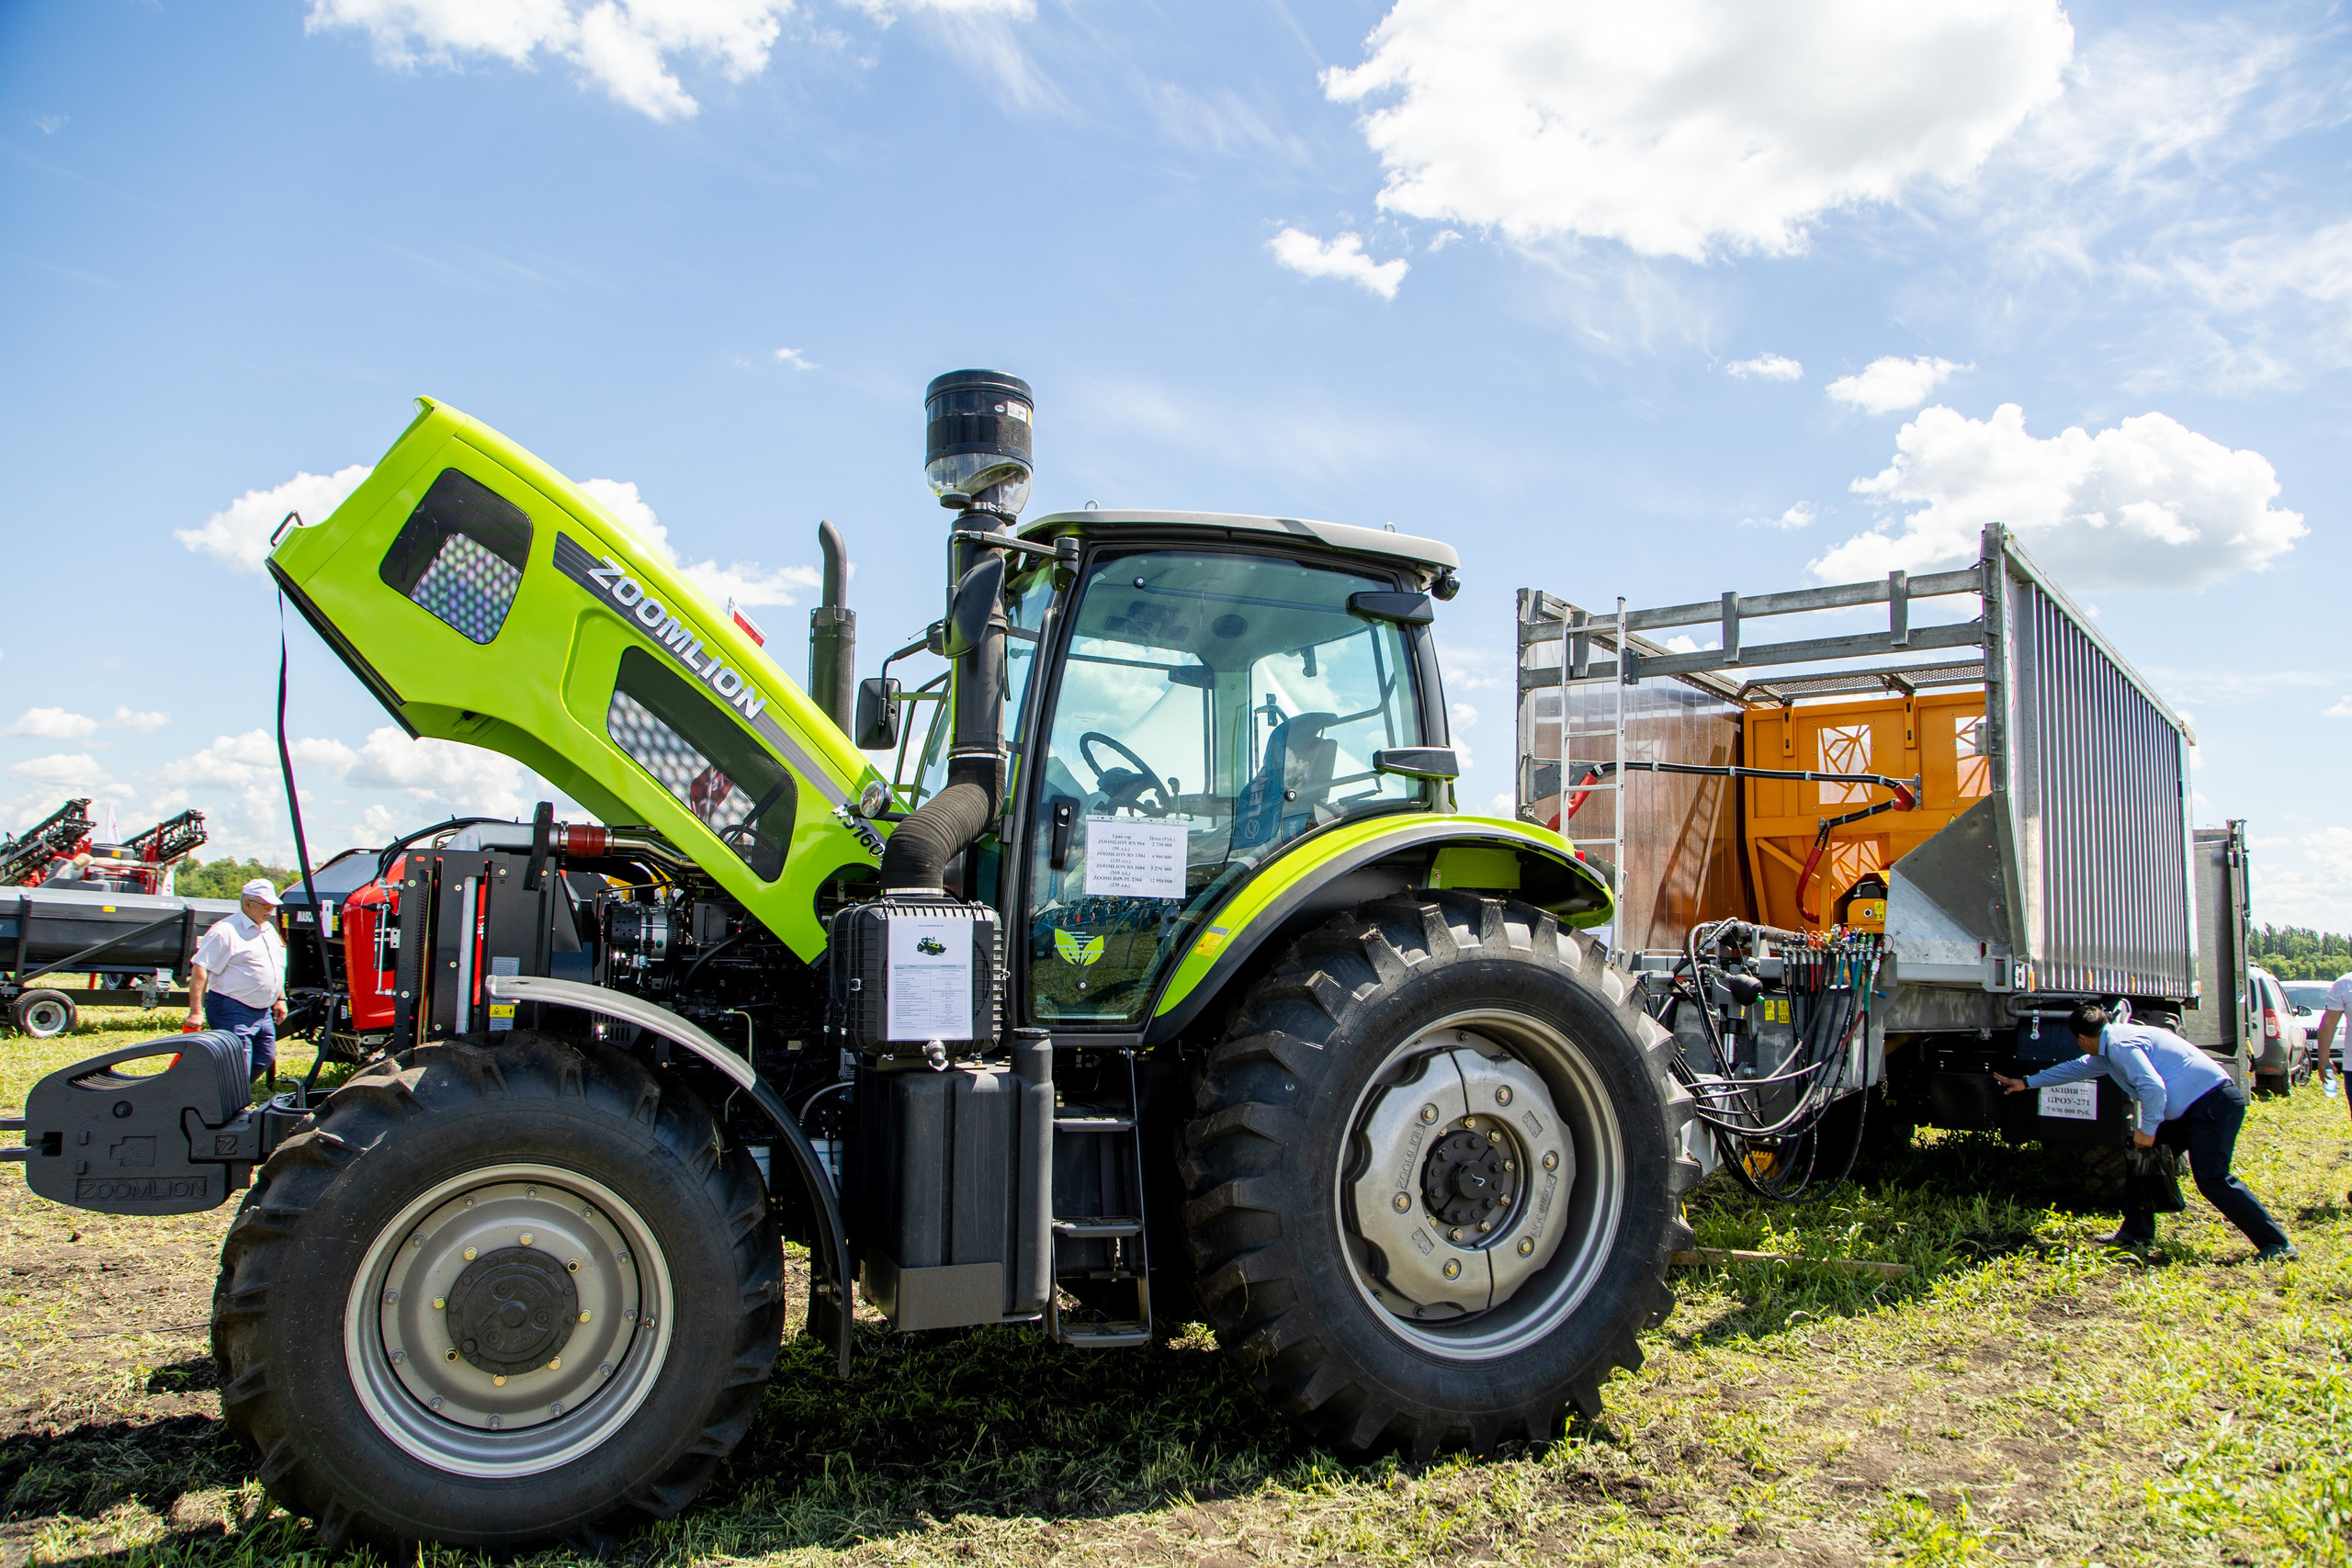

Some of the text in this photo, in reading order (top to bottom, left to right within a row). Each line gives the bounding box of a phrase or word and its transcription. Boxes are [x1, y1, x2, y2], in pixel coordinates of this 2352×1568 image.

[587, 555, 767, 720] ZOOMLION
[2048, 1097, 2090, 1106] ПРОУ-271
[2050, 1087, 2078, 1095] АКЦИЯ
[1395, 1122, 1426, 1190] ZOOMLION
[77, 1179, 207, 1200] ZOOMLION
